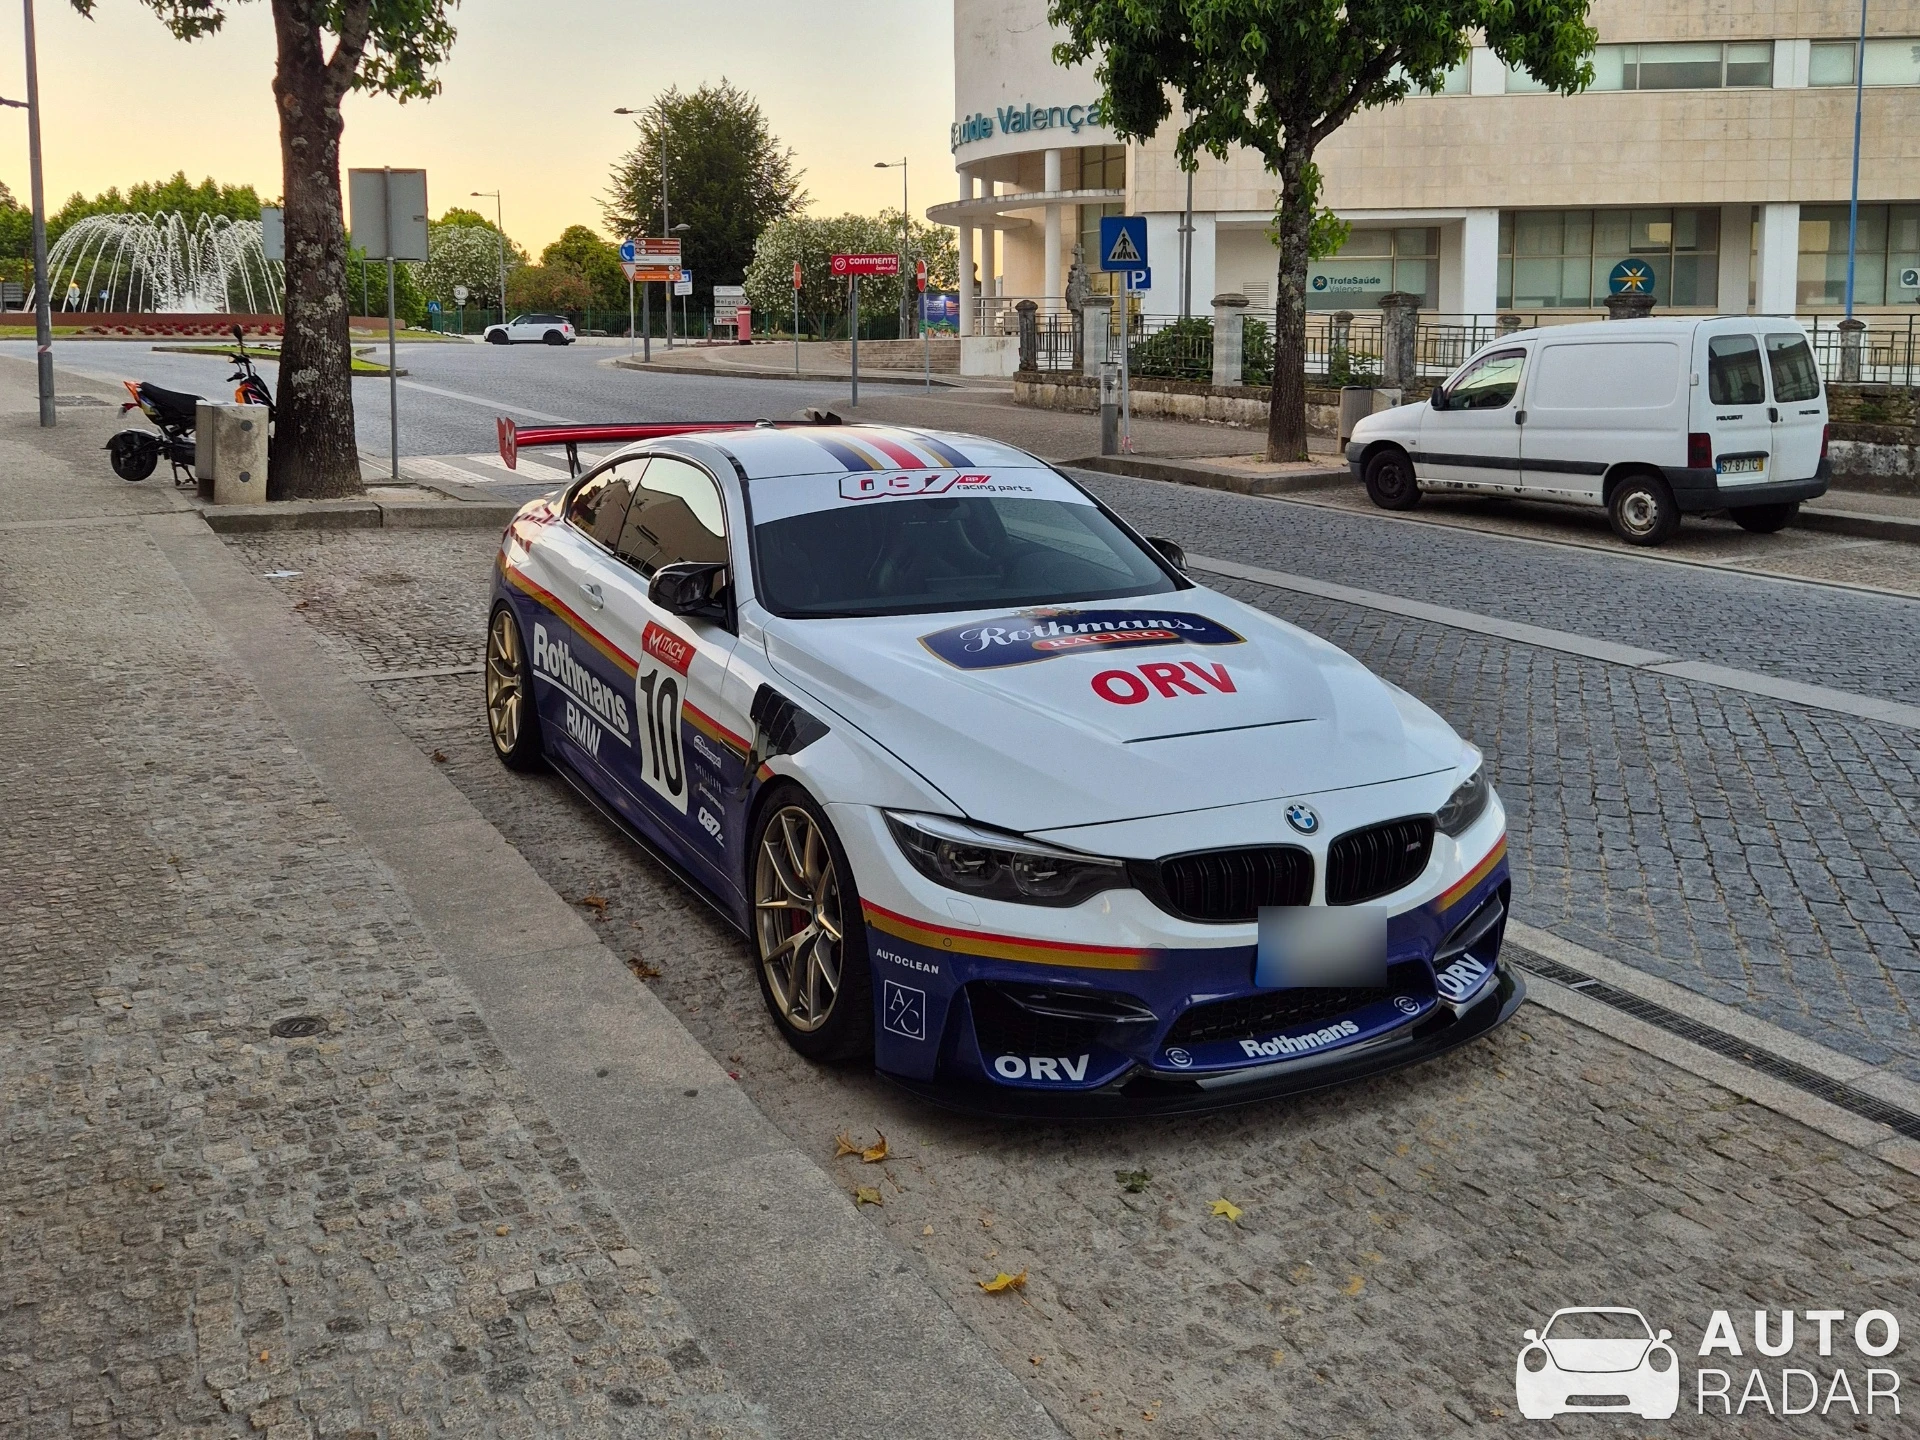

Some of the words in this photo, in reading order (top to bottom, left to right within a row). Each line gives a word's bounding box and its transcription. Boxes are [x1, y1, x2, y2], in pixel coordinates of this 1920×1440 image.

[997, 103, 1102, 134] Valença
[1131, 270, 1147, 290] P
[1328, 276, 1381, 285] TrofaSaúde
[1328, 285, 1363, 294] Valença
[956, 484, 996, 492] racing
[959, 614, 1205, 653] Rothmans
[1048, 630, 1166, 649] RACING
[533, 622, 630, 735] Rothmans
[1091, 661, 1238, 705] ORV
[566, 701, 602, 761] BMW
[640, 668, 683, 797] 10
[876, 948, 940, 975] AUTOCLEAN
[1437, 952, 1488, 994] ORV
[1239, 1019, 1360, 1058] Rothmans
[994, 1053, 1090, 1081] ORV
